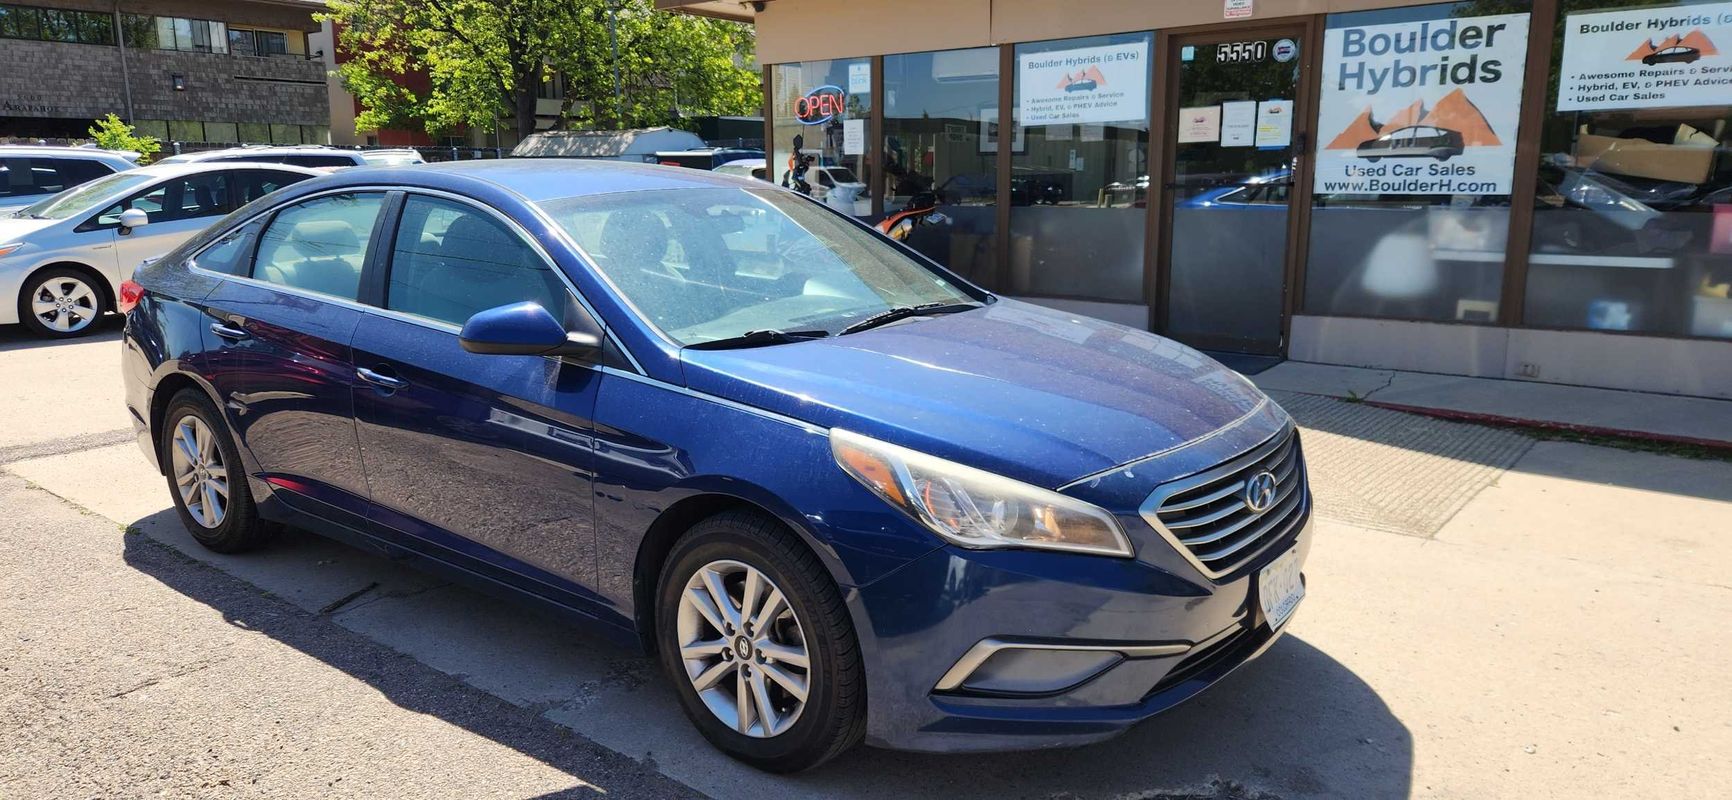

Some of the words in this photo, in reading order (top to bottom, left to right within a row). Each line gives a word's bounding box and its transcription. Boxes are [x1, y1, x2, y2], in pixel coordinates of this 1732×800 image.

[1579, 21, 1642, 34] Boulder
[1647, 15, 1711, 31] Hybrids
[1342, 21, 1506, 57] Boulder
[1217, 41, 1267, 63] 5550
[1028, 60, 1063, 70] Boulder
[1065, 55, 1101, 67] Hybrids
[1116, 51, 1140, 61] EVs)
[1338, 54, 1502, 95] Hybrids
[1579, 71, 1635, 81] Awesome
[1639, 68, 1685, 78] Repairs
[1577, 82, 1618, 93] Hybrid,
[1622, 82, 1640, 90] EV,
[1656, 79, 1690, 87] PHEV
[1031, 96, 1062, 104] Awesome
[1576, 94, 1605, 103] Used
[1609, 93, 1630, 102] Car
[1633, 91, 1665, 101] Sales
[794, 93, 844, 118] OPEN
[1344, 165, 1386, 177] Used
[1392, 164, 1420, 176] Car
[1428, 163, 1475, 176] Sales
[1324, 179, 1497, 193] www.BoulderH.com
